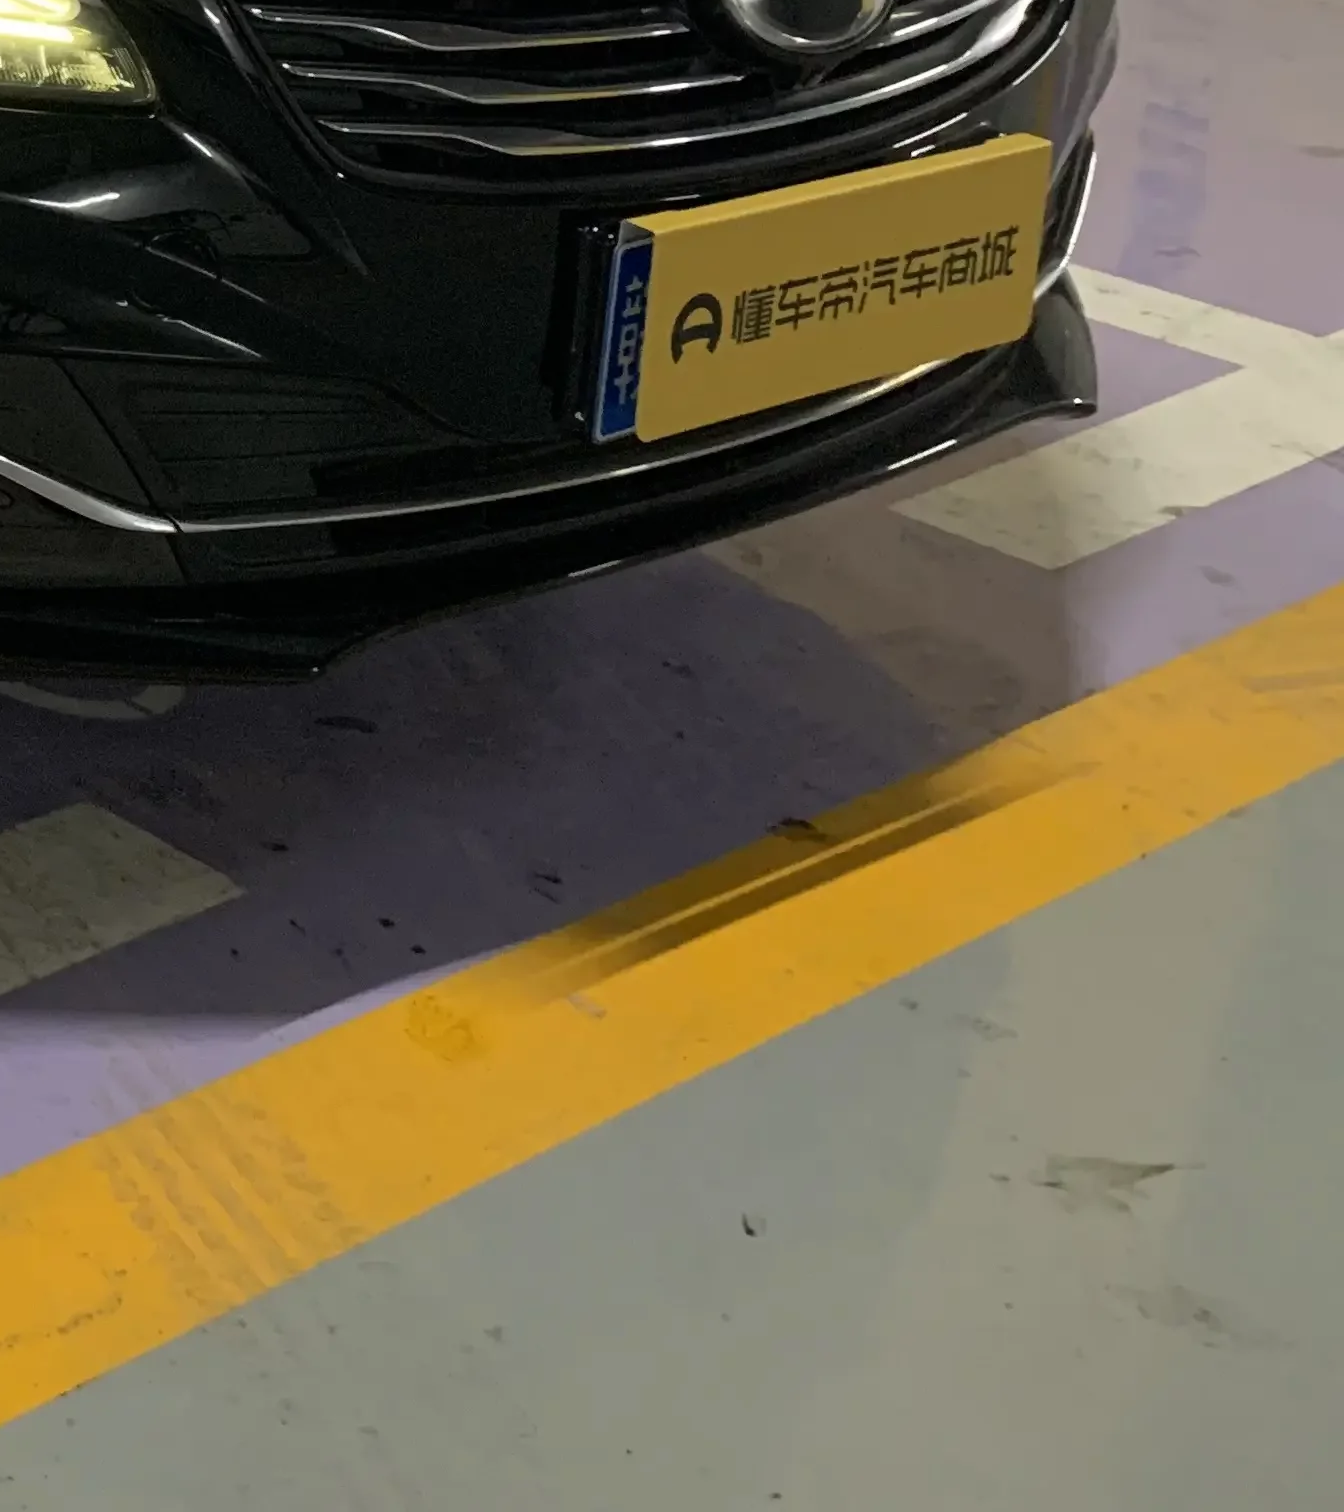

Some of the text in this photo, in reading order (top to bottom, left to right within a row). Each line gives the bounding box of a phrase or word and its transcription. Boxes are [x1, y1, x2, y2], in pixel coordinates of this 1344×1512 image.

[731, 225, 1019, 344] 懂车帝汽车商城
